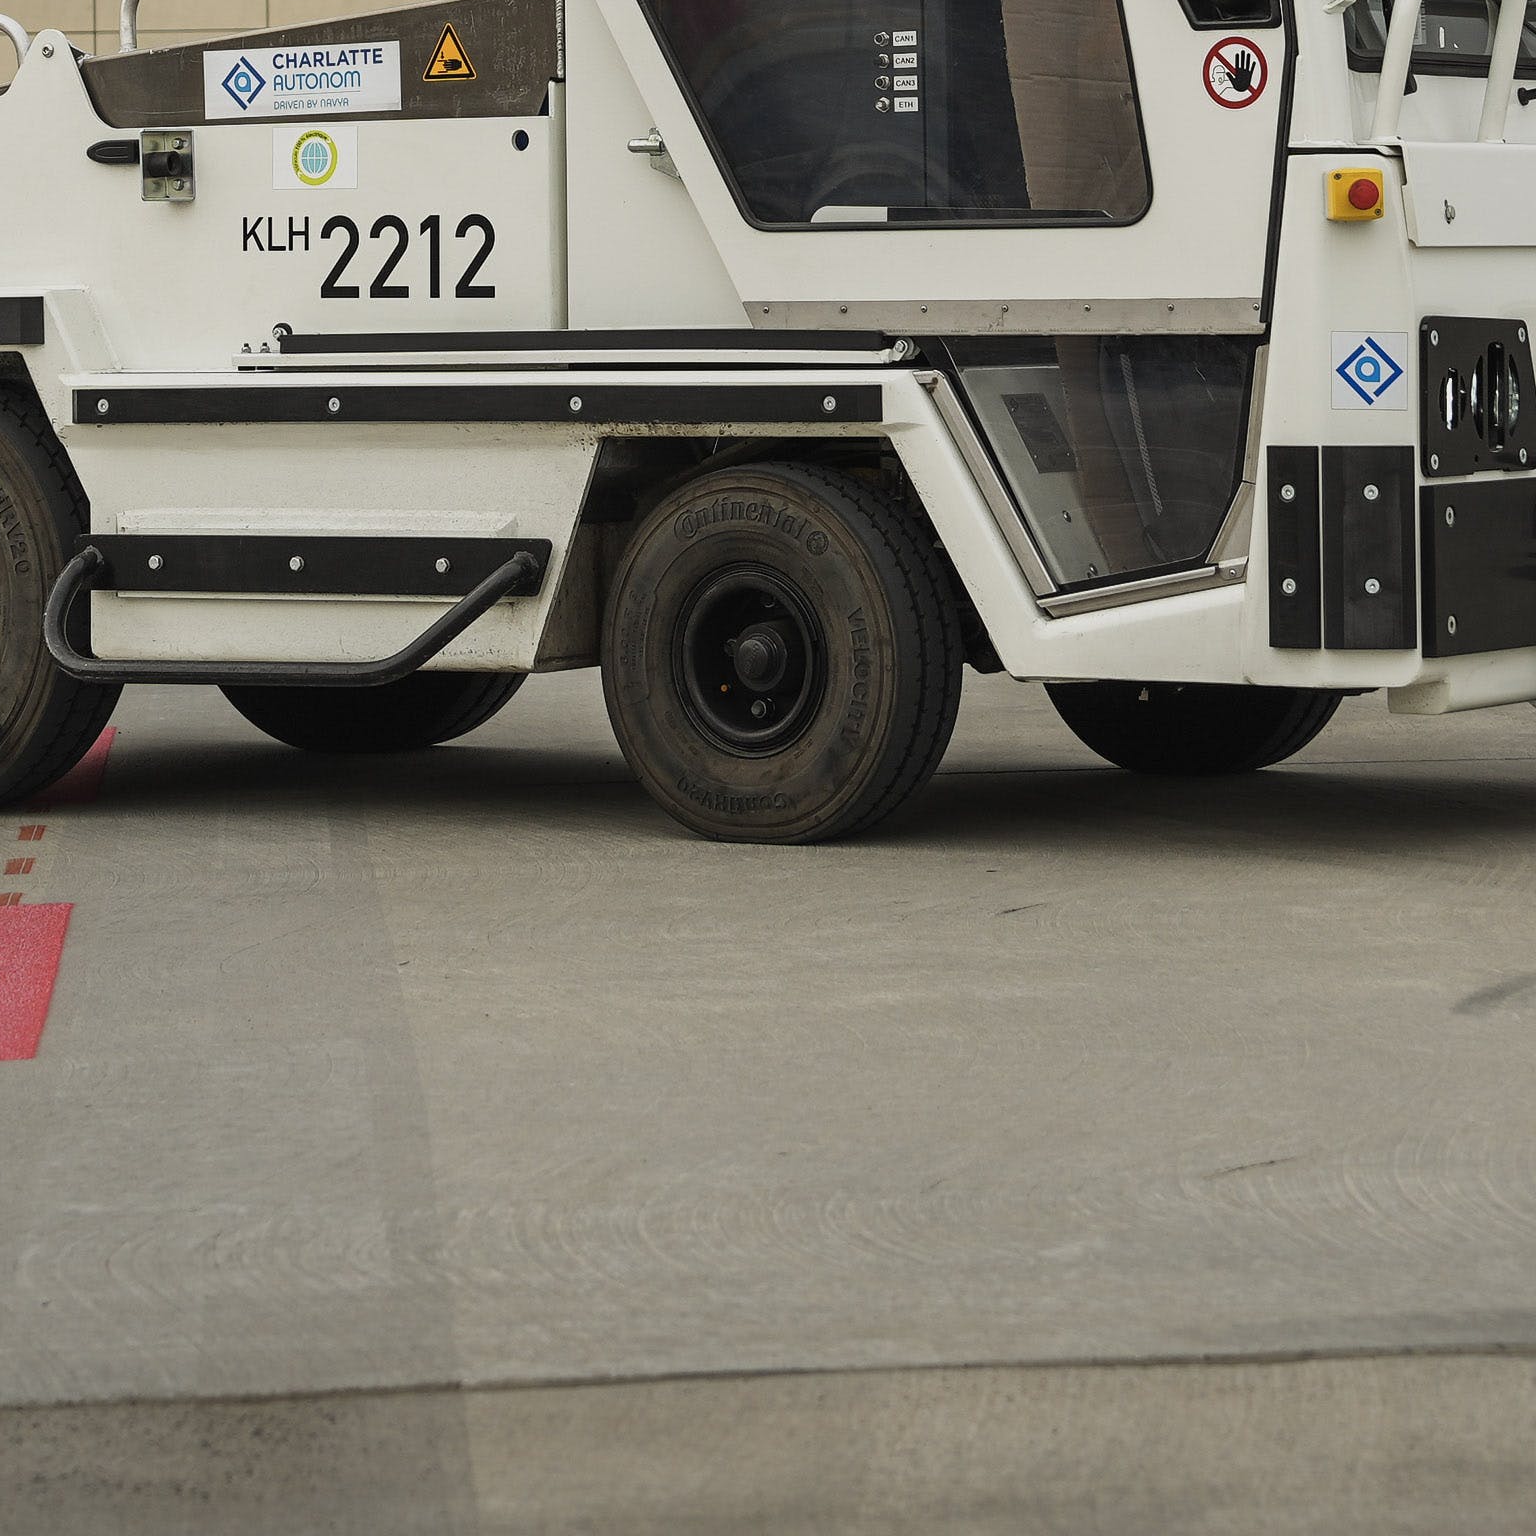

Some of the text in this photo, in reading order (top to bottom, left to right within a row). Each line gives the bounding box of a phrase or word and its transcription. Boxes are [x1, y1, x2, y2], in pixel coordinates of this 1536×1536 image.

[894, 35, 914, 43] CAN1
[272, 48, 383, 70] CHARLATTE
[895, 57, 915, 65] CAN2
[273, 70, 361, 91] AUTONOM
[895, 79, 916, 87] CAN3
[273, 97, 349, 111] DRIVEN BY NAVYA
[898, 101, 914, 109] ETH
[242, 213, 496, 299] KLH 2212
